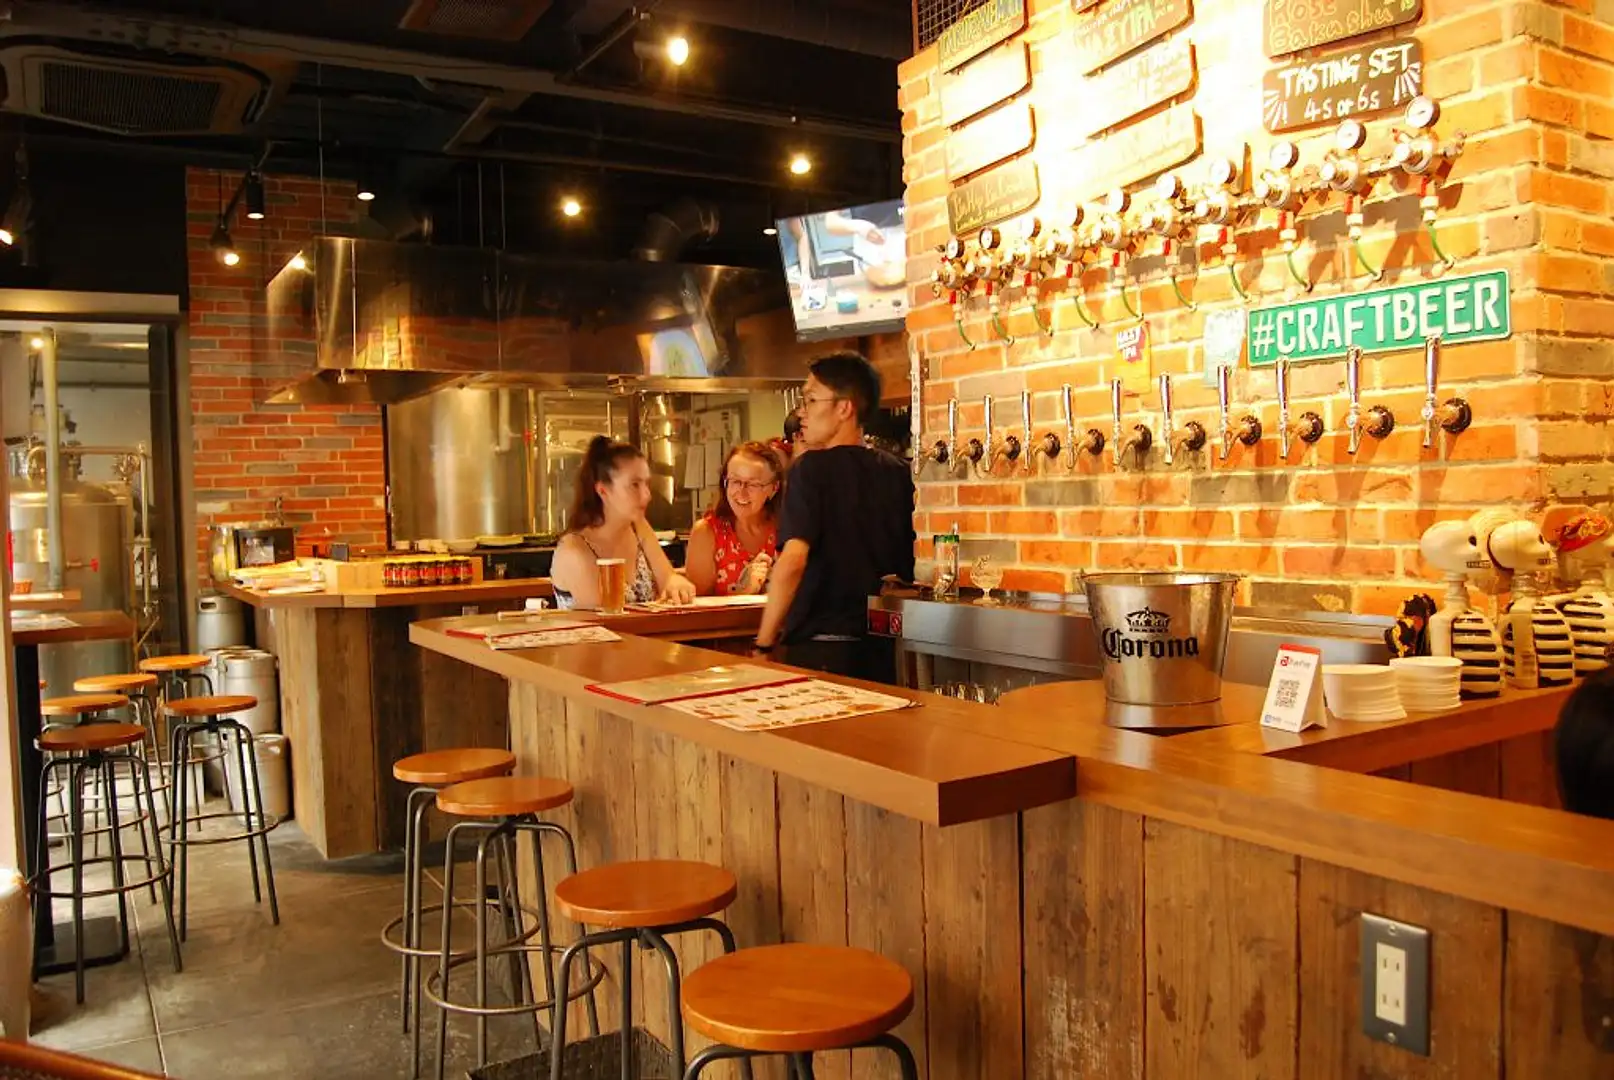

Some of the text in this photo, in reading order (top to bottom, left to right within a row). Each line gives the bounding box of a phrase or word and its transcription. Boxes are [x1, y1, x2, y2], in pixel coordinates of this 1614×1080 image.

[1278, 43, 1414, 98] TASTING SET
[1337, 98, 1354, 117] or
[1253, 279, 1501, 358] #CRAFTBEER
[1102, 627, 1200, 663] Corona
